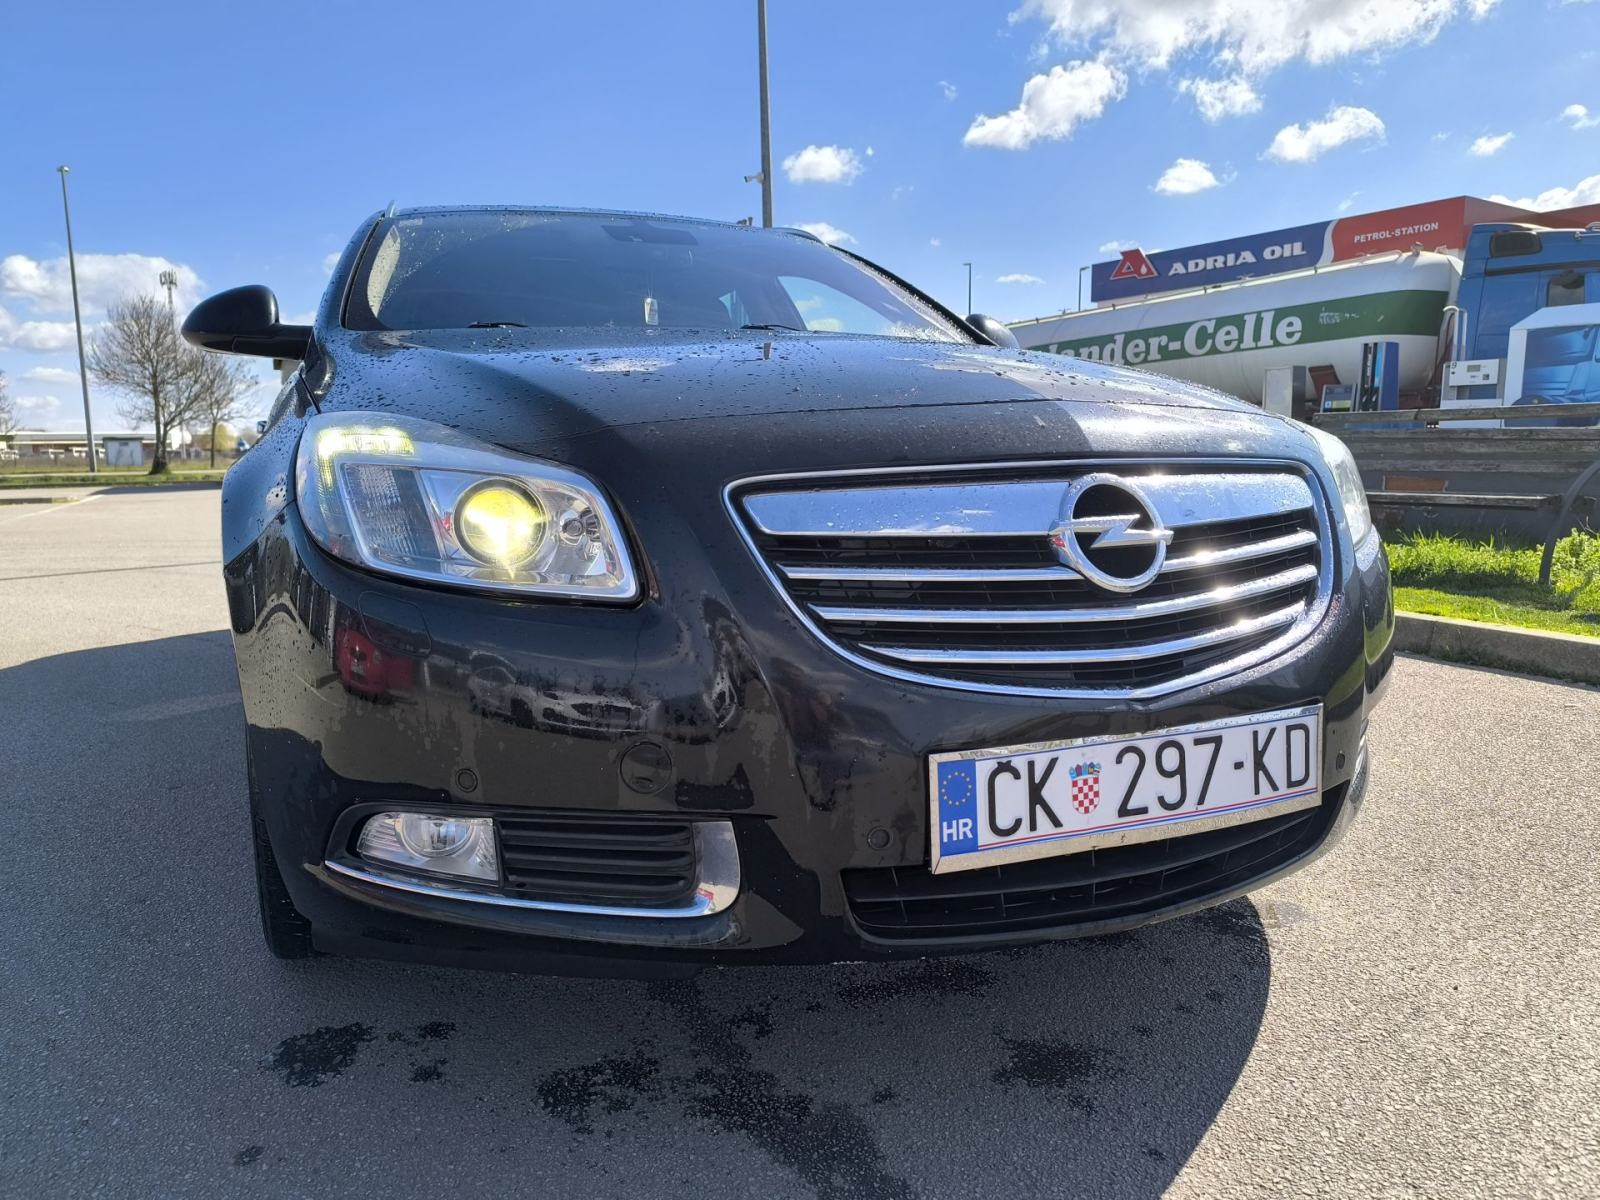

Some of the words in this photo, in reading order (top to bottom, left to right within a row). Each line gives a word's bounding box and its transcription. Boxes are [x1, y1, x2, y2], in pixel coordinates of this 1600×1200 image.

[1354, 222, 1439, 243] PETROL-STATION
[1168, 251, 1257, 276] ADRIA
[1263, 242, 1307, 260] OIL
[988, 757, 1063, 837] ČK
[1116, 723, 1309, 818] 297-KD
[942, 818, 973, 842] HR
